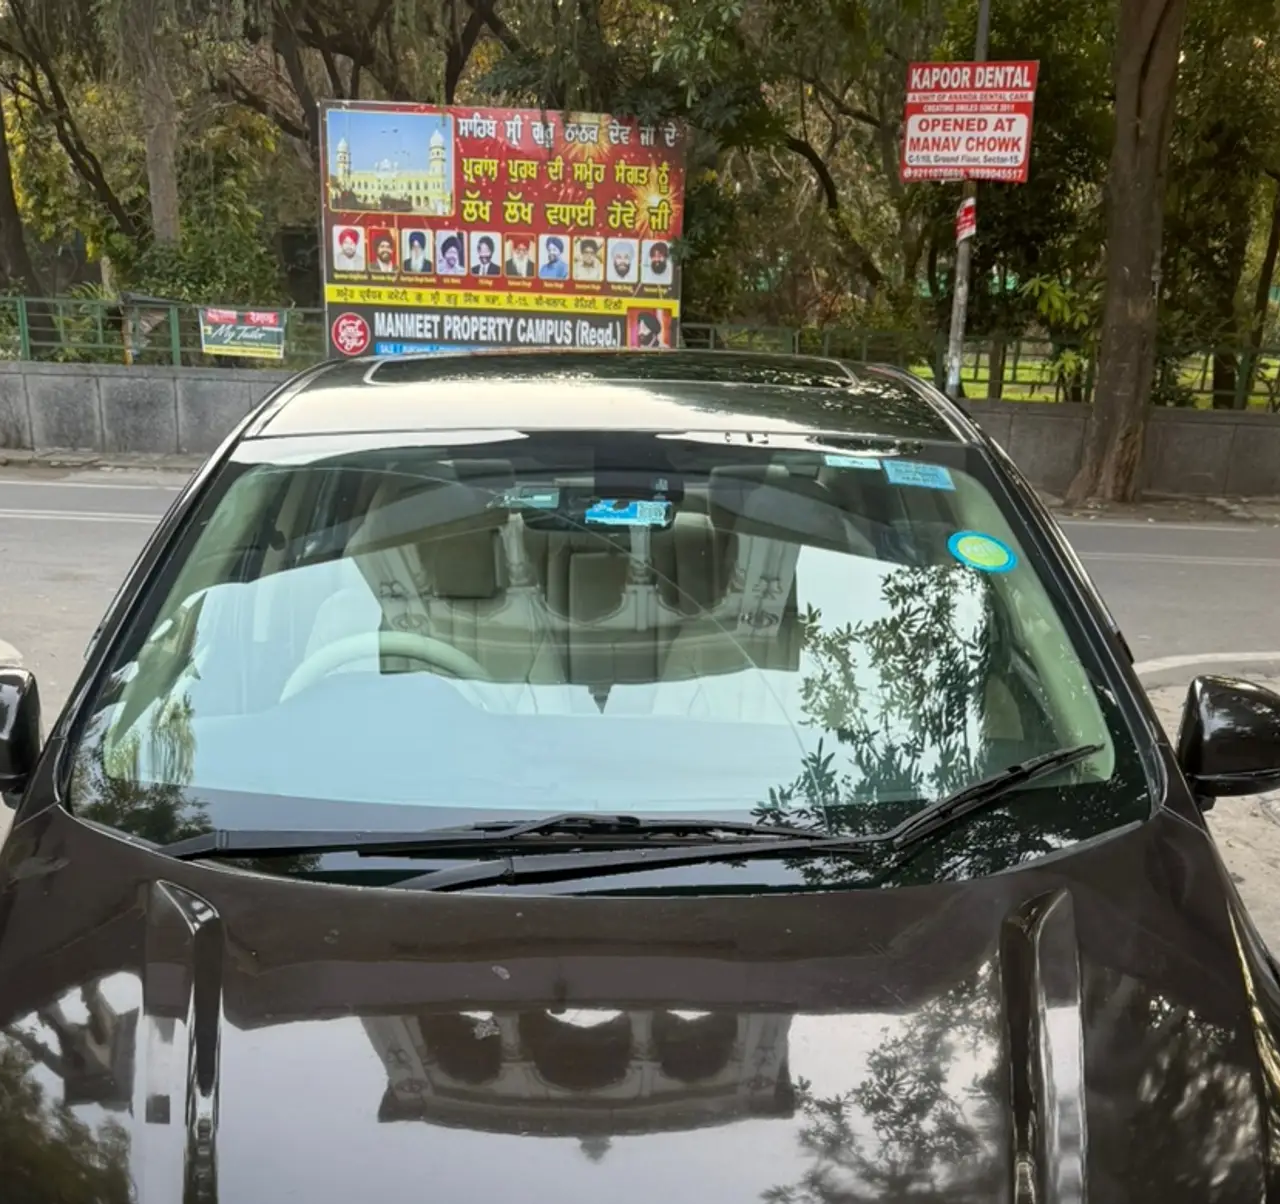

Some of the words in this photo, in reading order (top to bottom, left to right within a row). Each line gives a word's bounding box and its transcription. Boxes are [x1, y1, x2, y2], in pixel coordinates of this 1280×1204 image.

[911, 67, 971, 89] KAPOOR
[974, 66, 1031, 88] DENTAL
[457, 112, 497, 139] ਸਾਹਿਬ
[504, 114, 523, 147] ਸ੍ਰੀ
[608, 119, 631, 144] ਦੇਵ
[918, 118, 988, 132] OPENED
[993, 118, 1017, 132] AT
[908, 136, 962, 152] MANAV
[965, 136, 1022, 152] CHOWK
[508, 159, 539, 182] ਪੁਰਬ
[547, 155, 564, 182] ਦੀ
[615, 158, 650, 186] ਸੰਗਤ
[461, 190, 492, 224] ਲੱਖ
[503, 191, 534, 225] ਲੱਖ
[545, 197, 596, 228] ਵਧਾਈ
[607, 200, 637, 231] ਹੋਵੇ
[648, 201, 672, 231] ਜੀ
[211, 323, 236, 344] My
[374, 311, 441, 339] MANMEET
[443, 314, 515, 342] PROPERTY
[516, 318, 574, 345] CAMPUS
